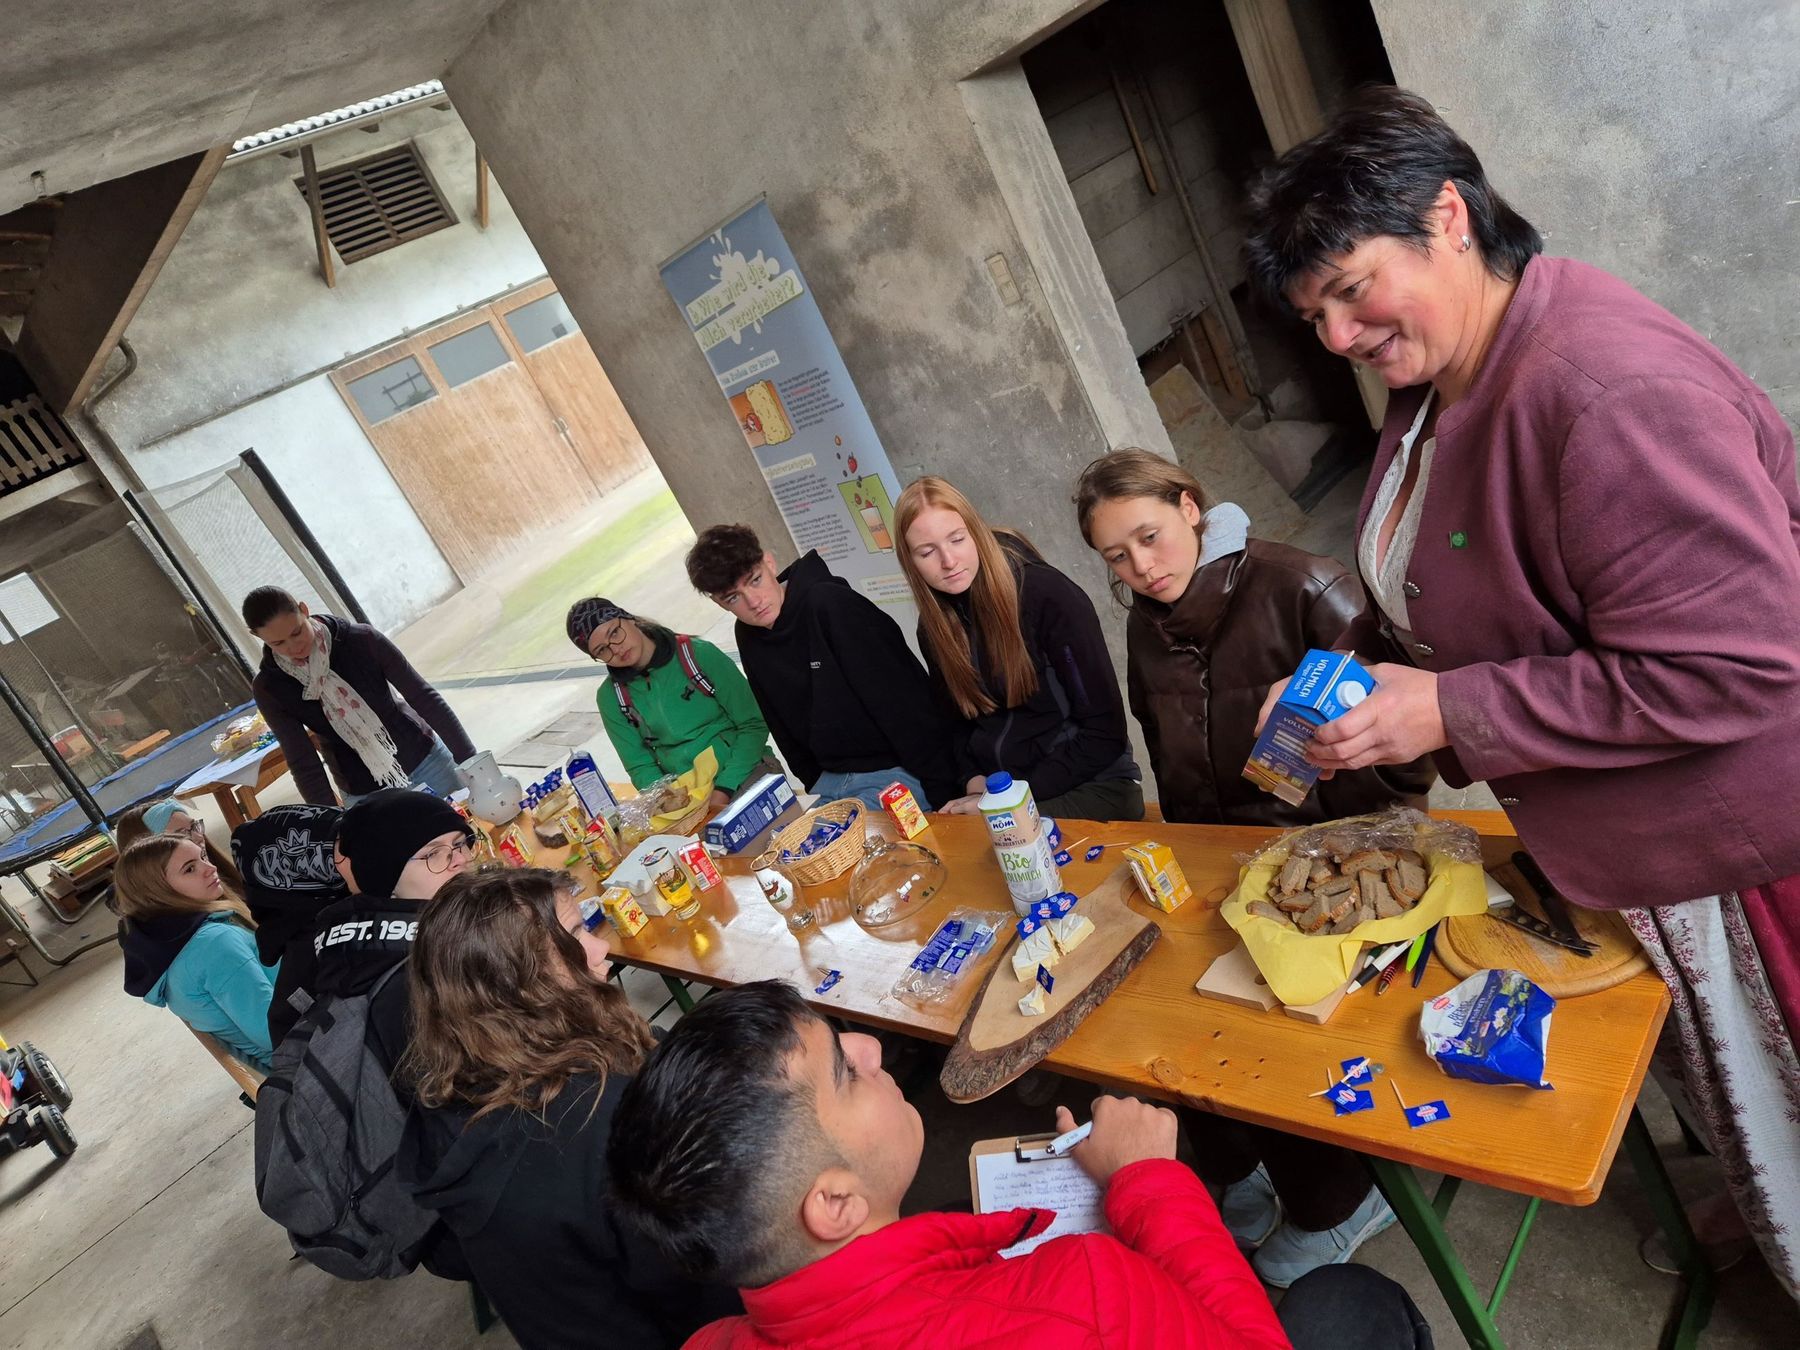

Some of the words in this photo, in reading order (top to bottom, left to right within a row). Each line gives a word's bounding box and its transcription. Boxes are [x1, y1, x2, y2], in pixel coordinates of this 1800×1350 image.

[1299, 658, 1330, 698] VOLLMILCH
[1283, 717, 1317, 737] VOLLMI
[1001, 852, 1032, 871] Bio
[325, 920, 374, 947] EST.
